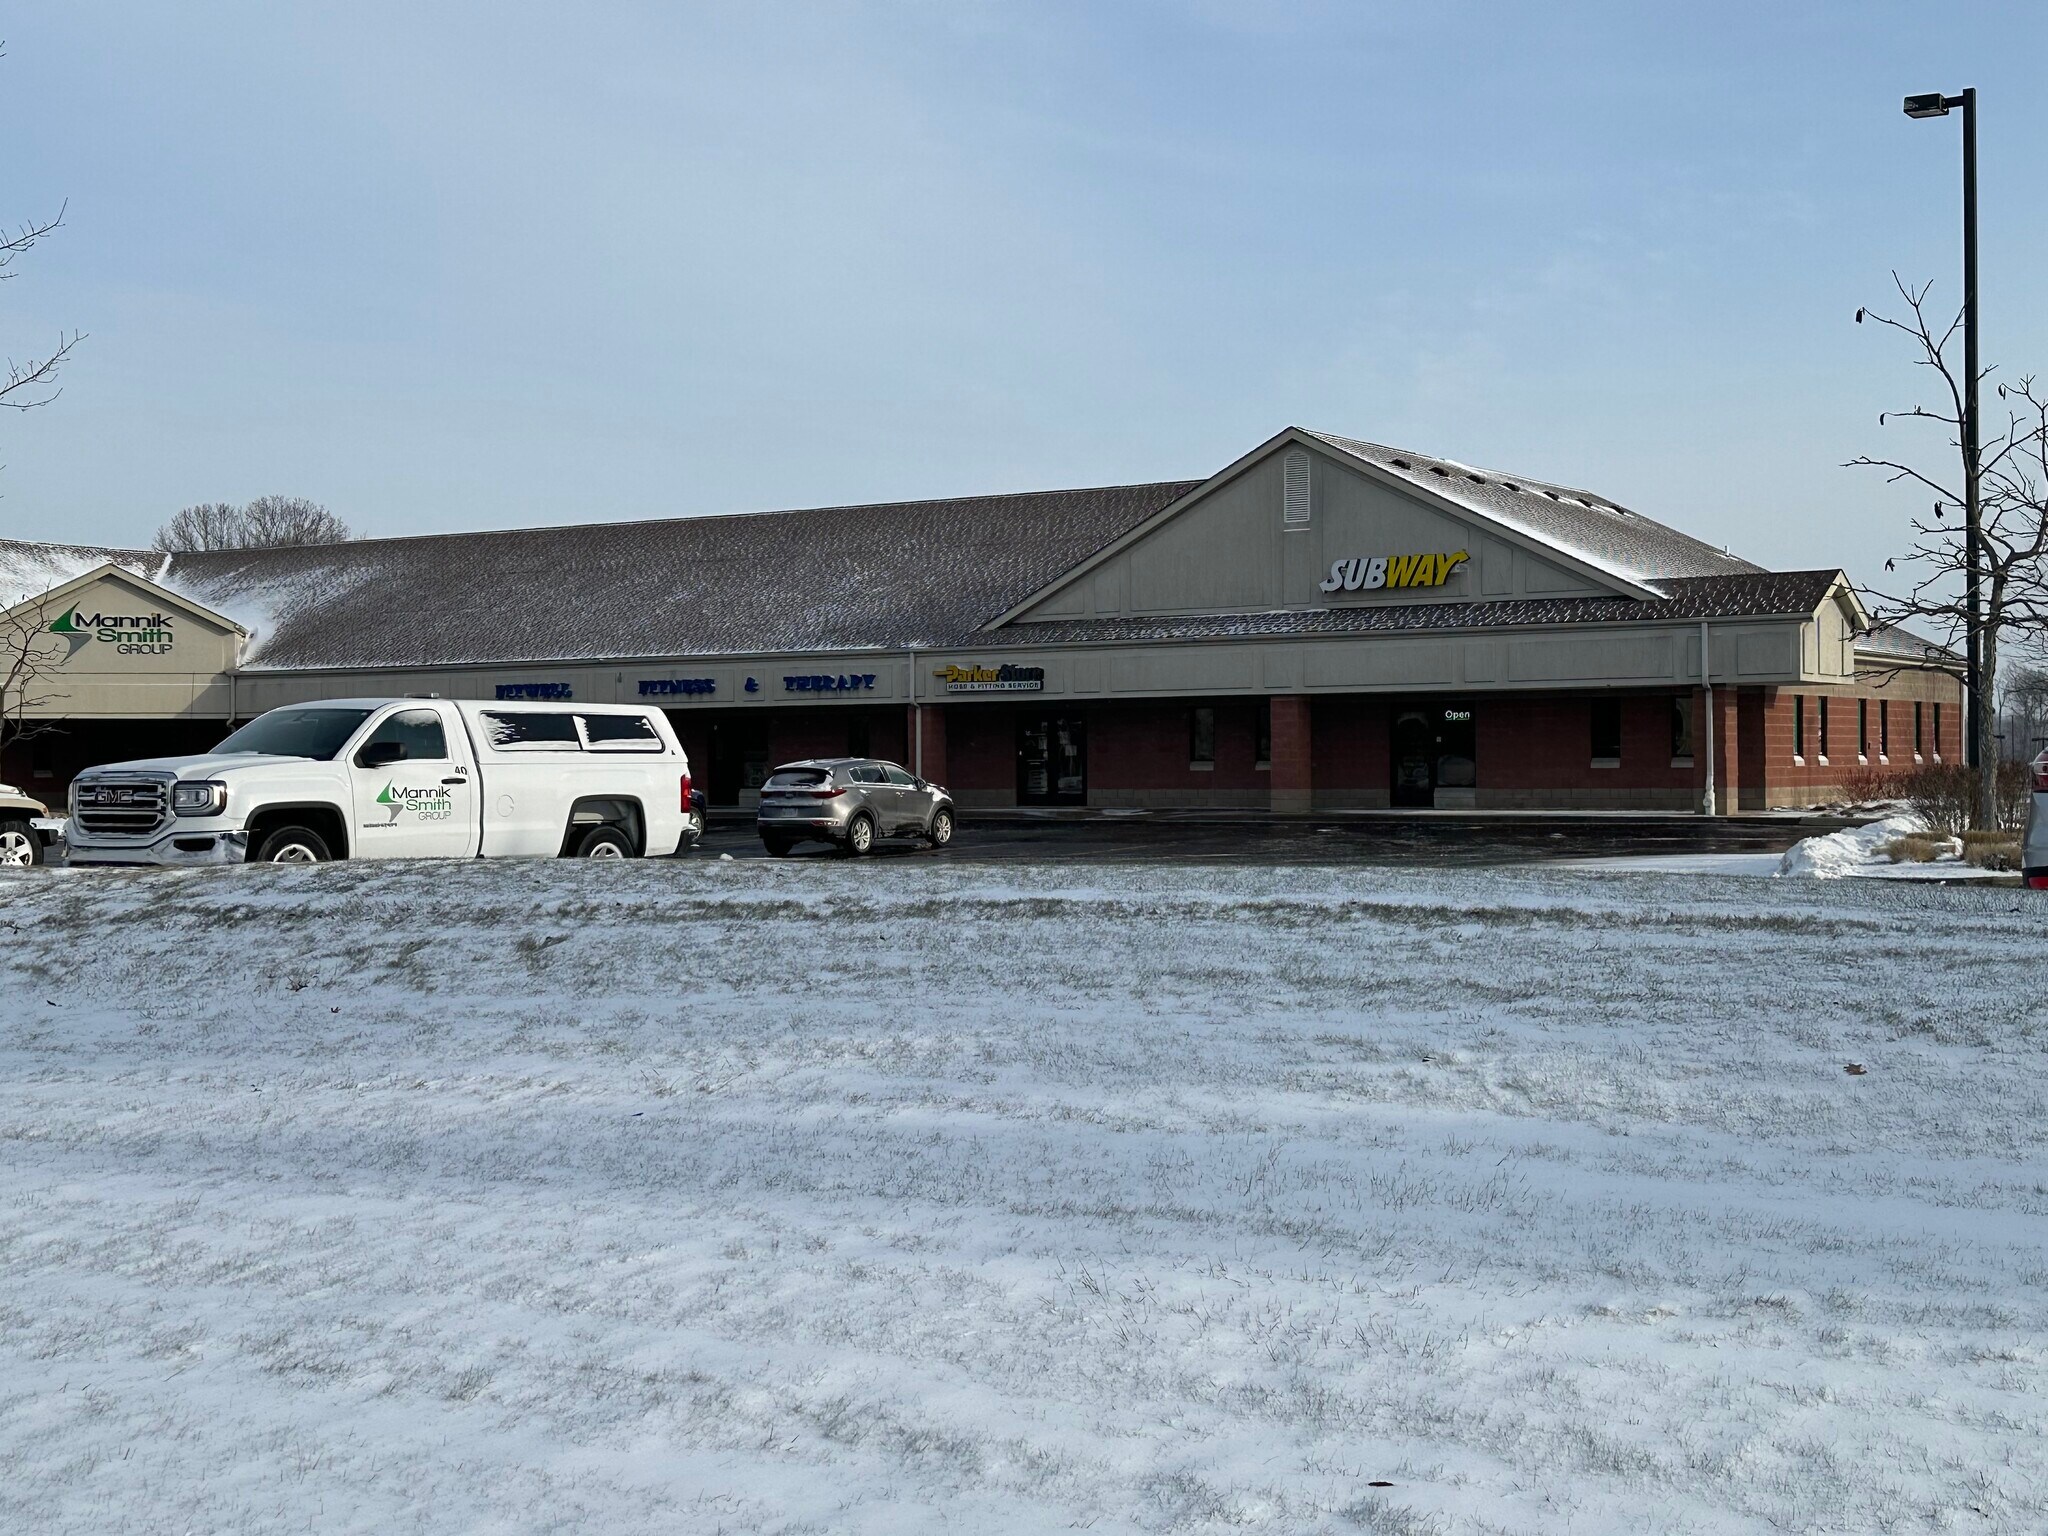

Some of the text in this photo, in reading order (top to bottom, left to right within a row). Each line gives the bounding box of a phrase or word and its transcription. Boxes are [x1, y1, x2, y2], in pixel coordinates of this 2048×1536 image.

[1319, 549, 1471, 594] SUBWAY
[75, 612, 173, 628] Mannik
[96, 628, 173, 642] Smith
[117, 644, 173, 654] GROUP
[744, 677, 759, 693] &
[783, 674, 876, 691] THERAPY
[1445, 710, 1470, 720] Open
[94, 789, 133, 804] GMC
[392, 786, 451, 799] Mannik
[406, 798, 452, 811] Smith
[418, 811, 452, 821] GROUP
